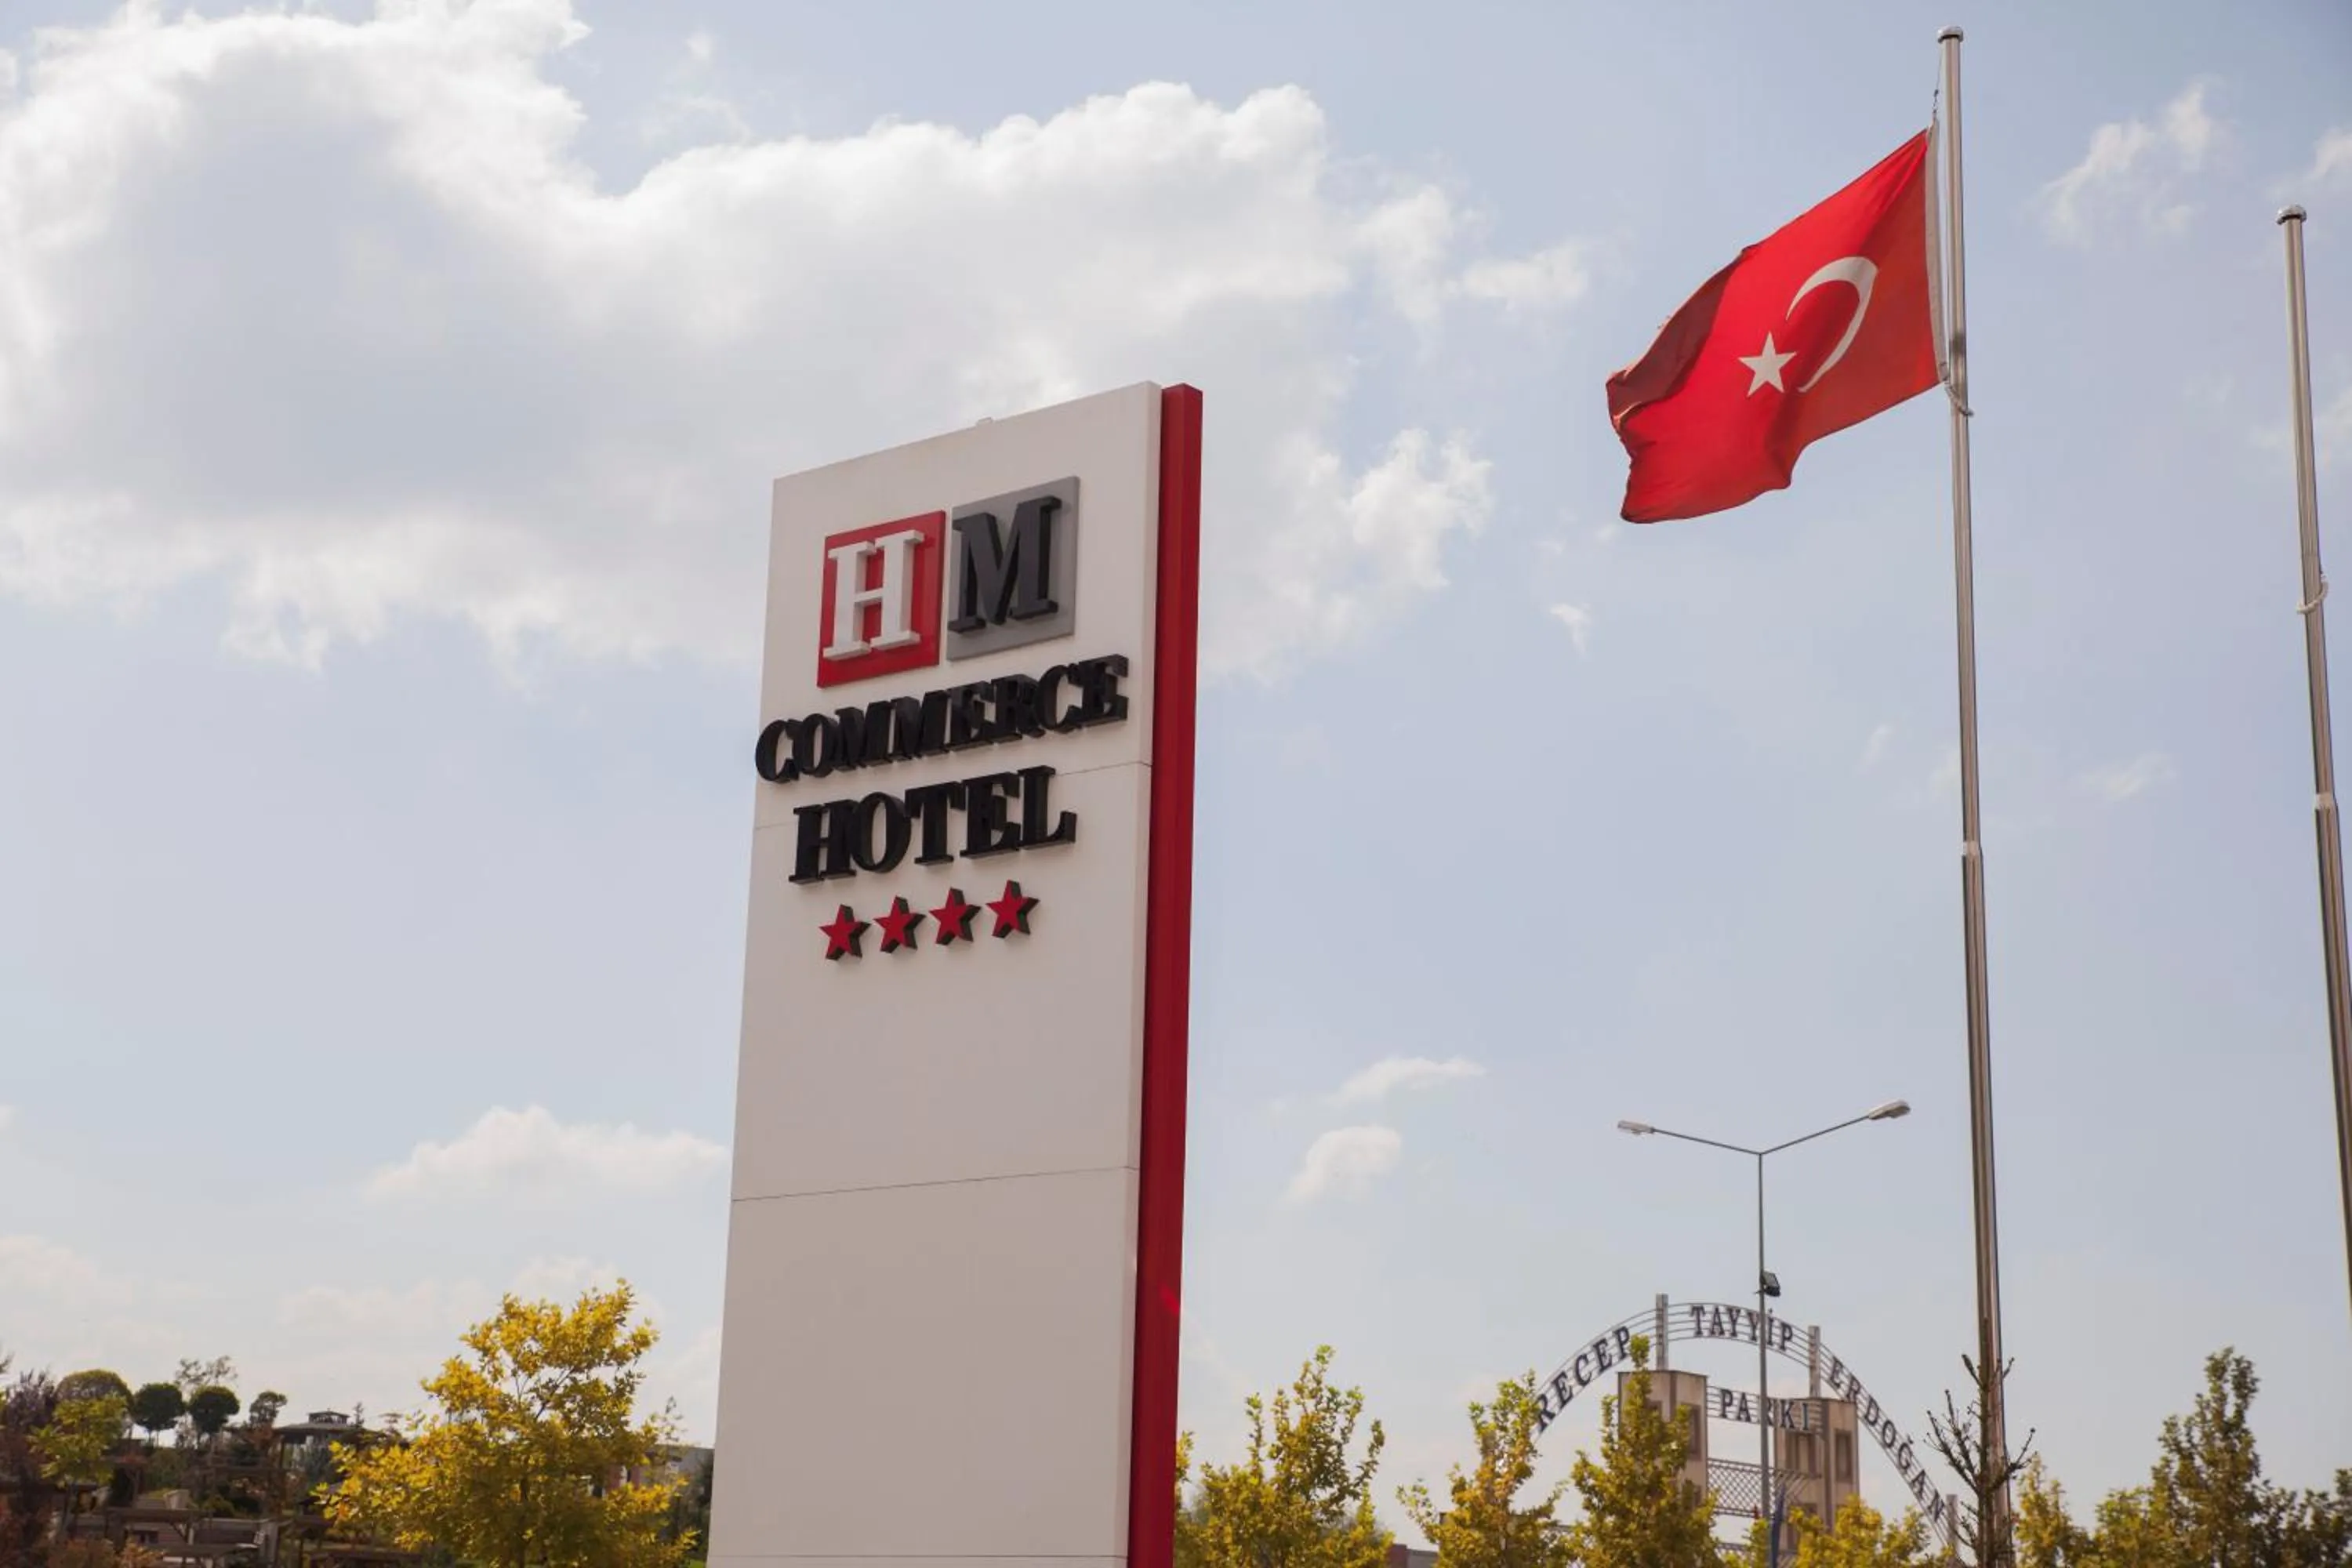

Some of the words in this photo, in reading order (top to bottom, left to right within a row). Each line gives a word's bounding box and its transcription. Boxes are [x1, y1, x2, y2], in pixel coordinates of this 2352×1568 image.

[755, 654, 1129, 783] COMMERCE
[789, 764, 1076, 884] HOTEL
[1534, 1326, 1630, 1432] RECEP
[1690, 1305, 1793, 1351] TAYYİP
[1830, 1356, 1945, 1523] ERDOĞAN
